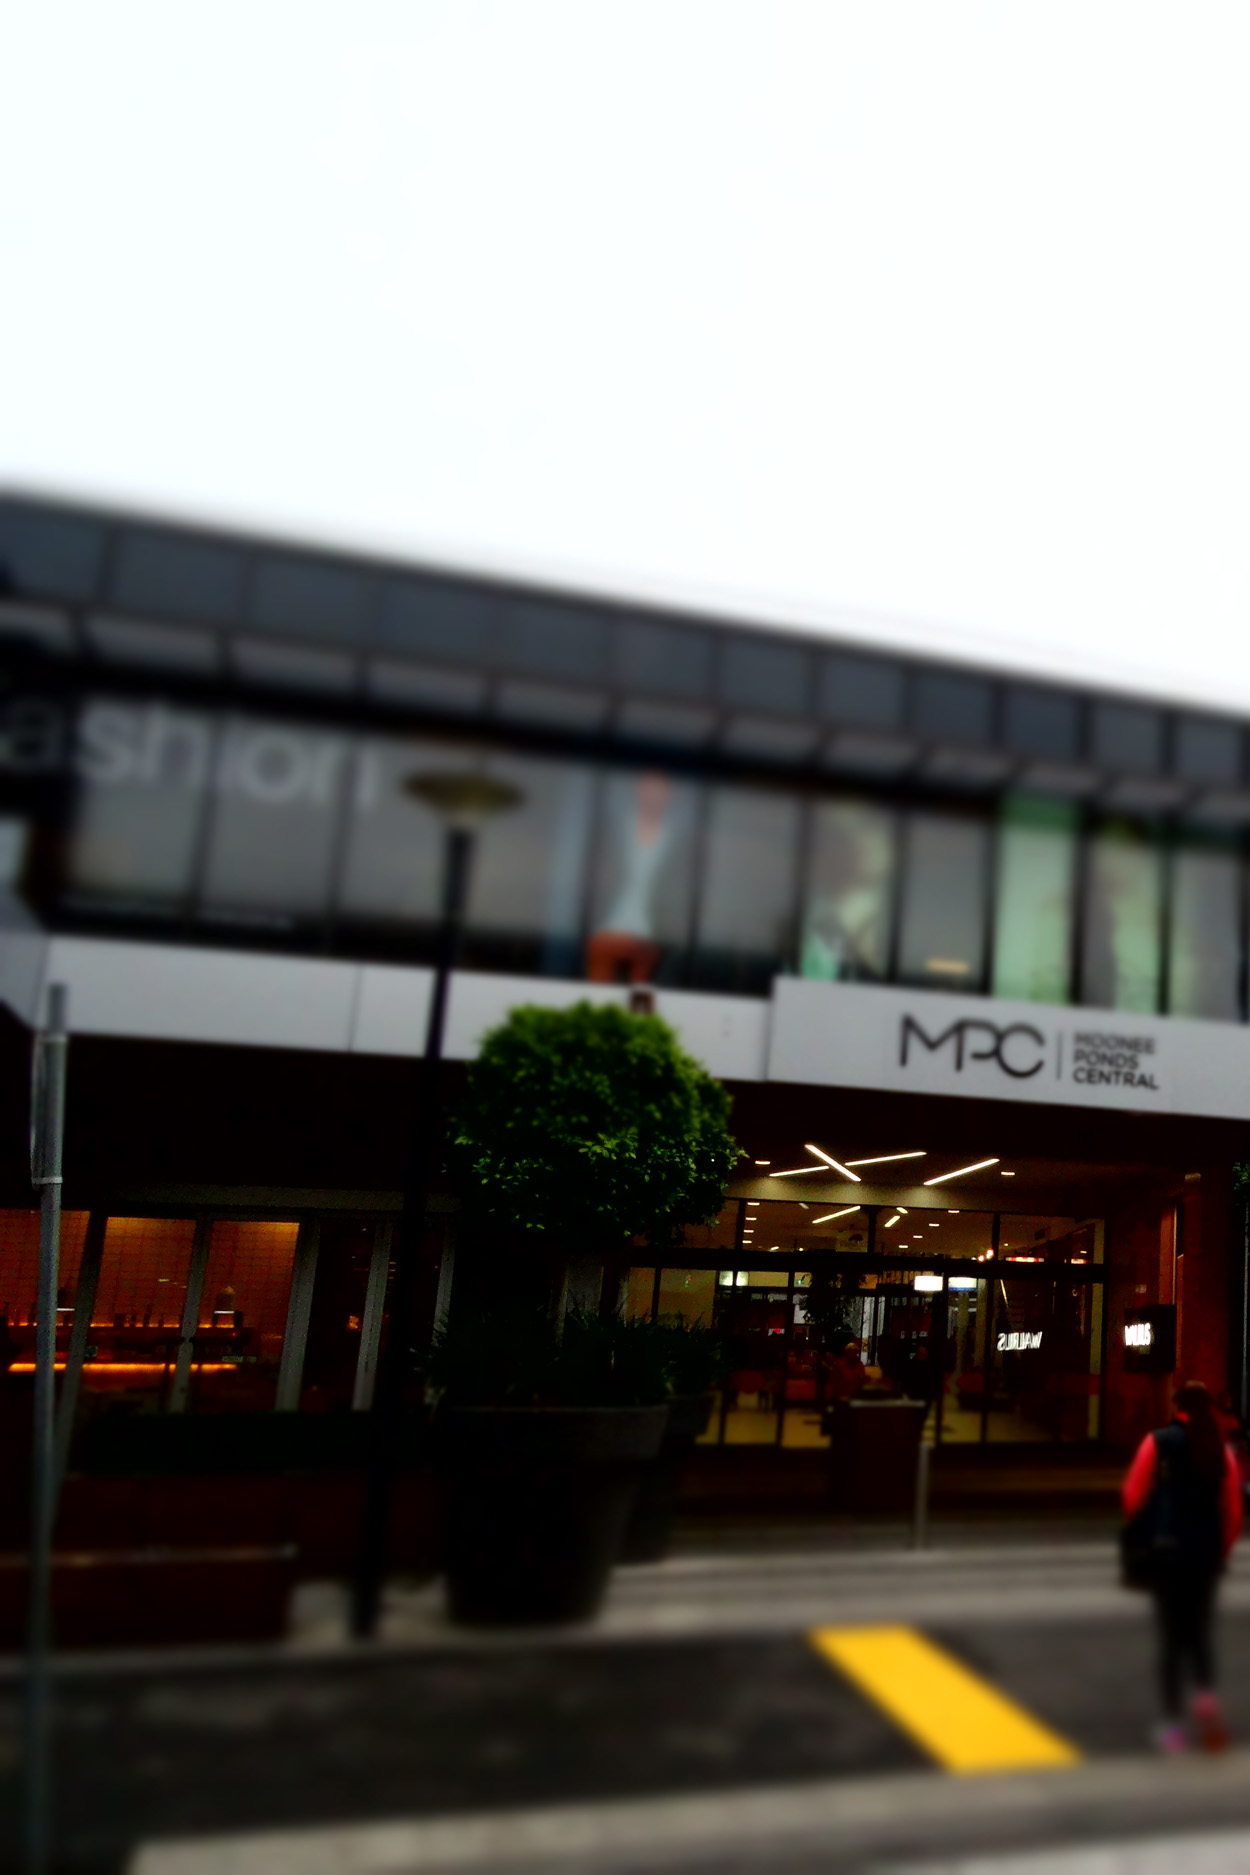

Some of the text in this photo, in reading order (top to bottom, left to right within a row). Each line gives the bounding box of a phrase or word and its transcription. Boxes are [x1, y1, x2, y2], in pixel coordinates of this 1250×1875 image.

[900, 1014, 1044, 1079] MPC
[1074, 1033, 1156, 1054] MOONEE
[1073, 1050, 1138, 1069] PONDS
[1073, 1067, 1159, 1090] CENTRAL
